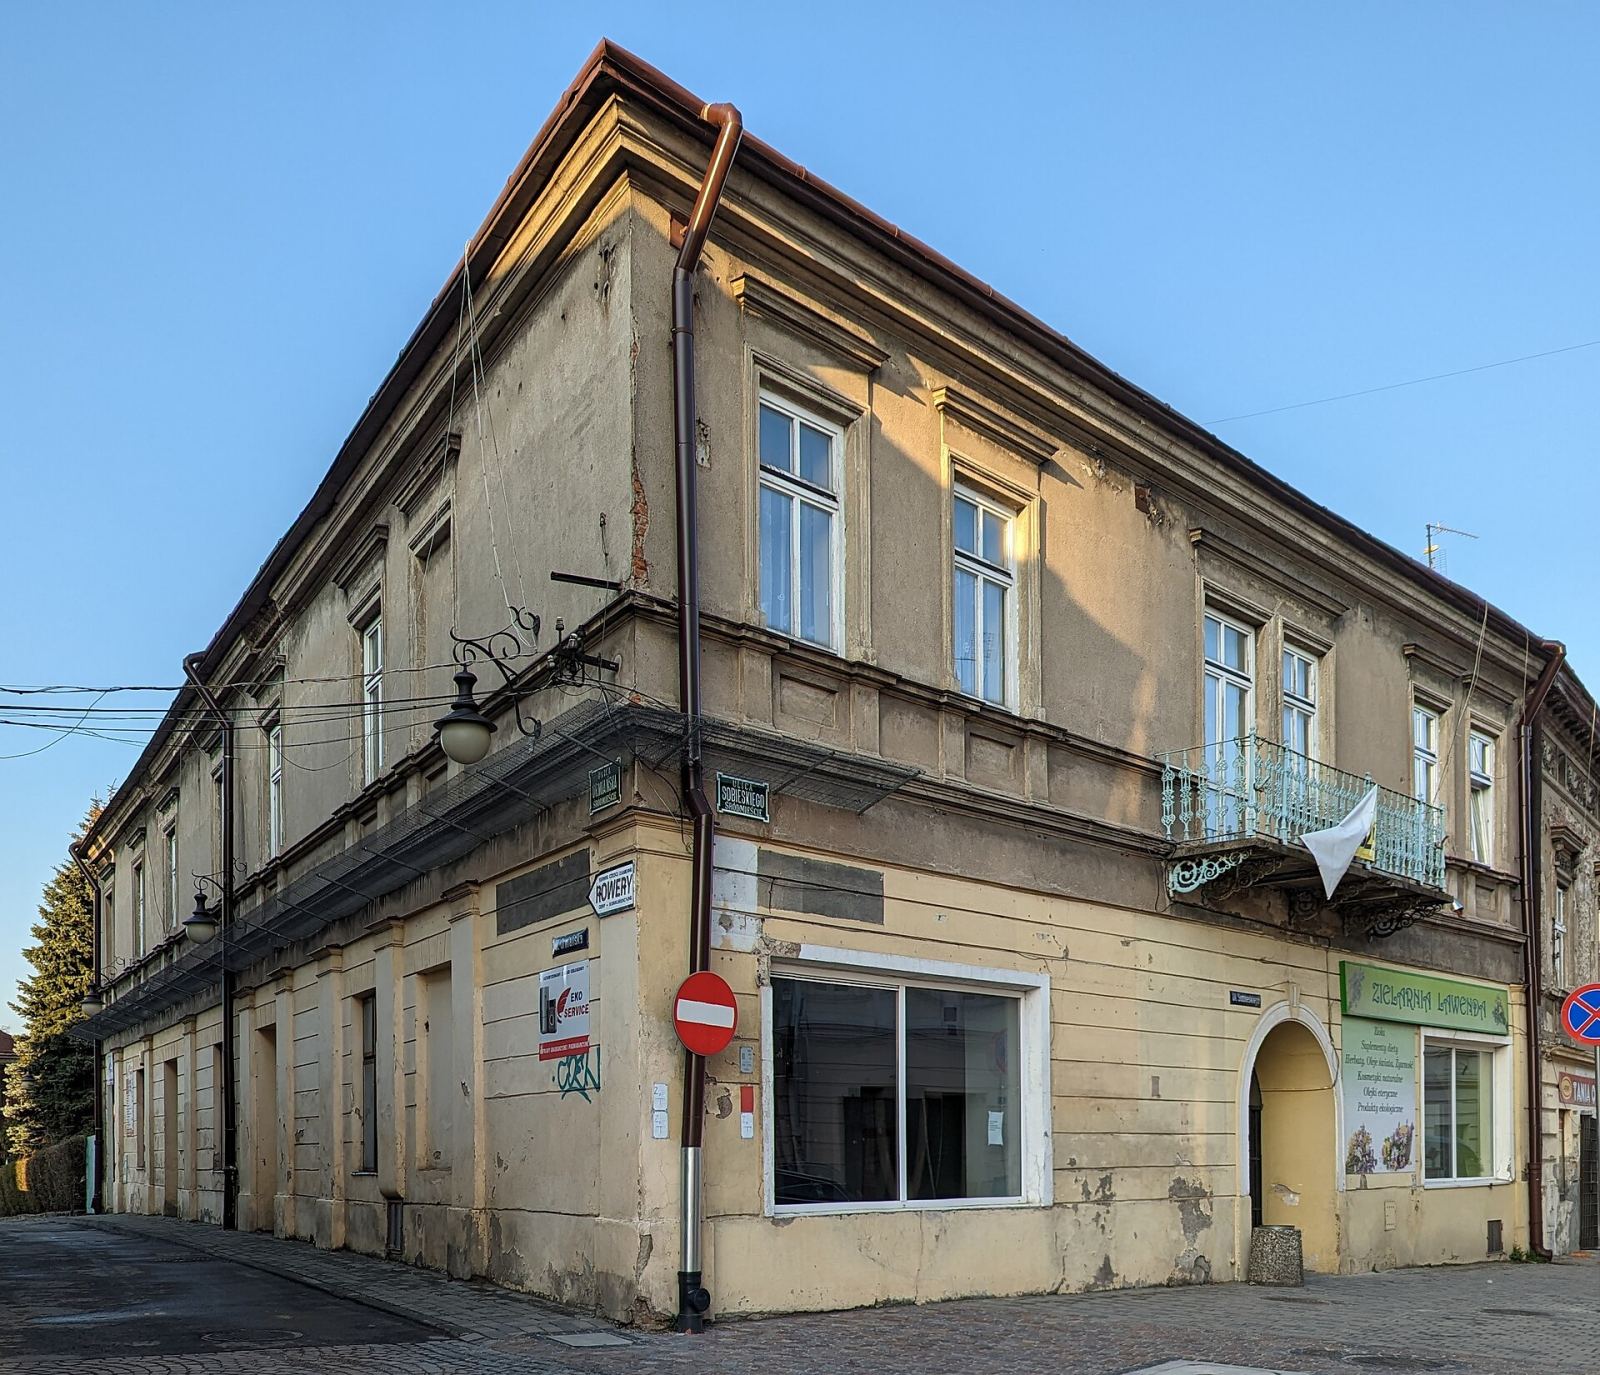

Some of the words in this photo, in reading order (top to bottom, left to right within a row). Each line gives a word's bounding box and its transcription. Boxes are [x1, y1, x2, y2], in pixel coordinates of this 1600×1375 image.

[732, 779, 754, 792] ULICA
[721, 785, 765, 809] SOBIESKIEGO
[595, 873, 633, 904] ROWERY
[570, 990, 583, 1003] EKO
[1372, 982, 1432, 1012] ZIELARNIA
[1437, 992, 1486, 1020] LAWENDA
[563, 1003, 590, 1018] SERVICE
